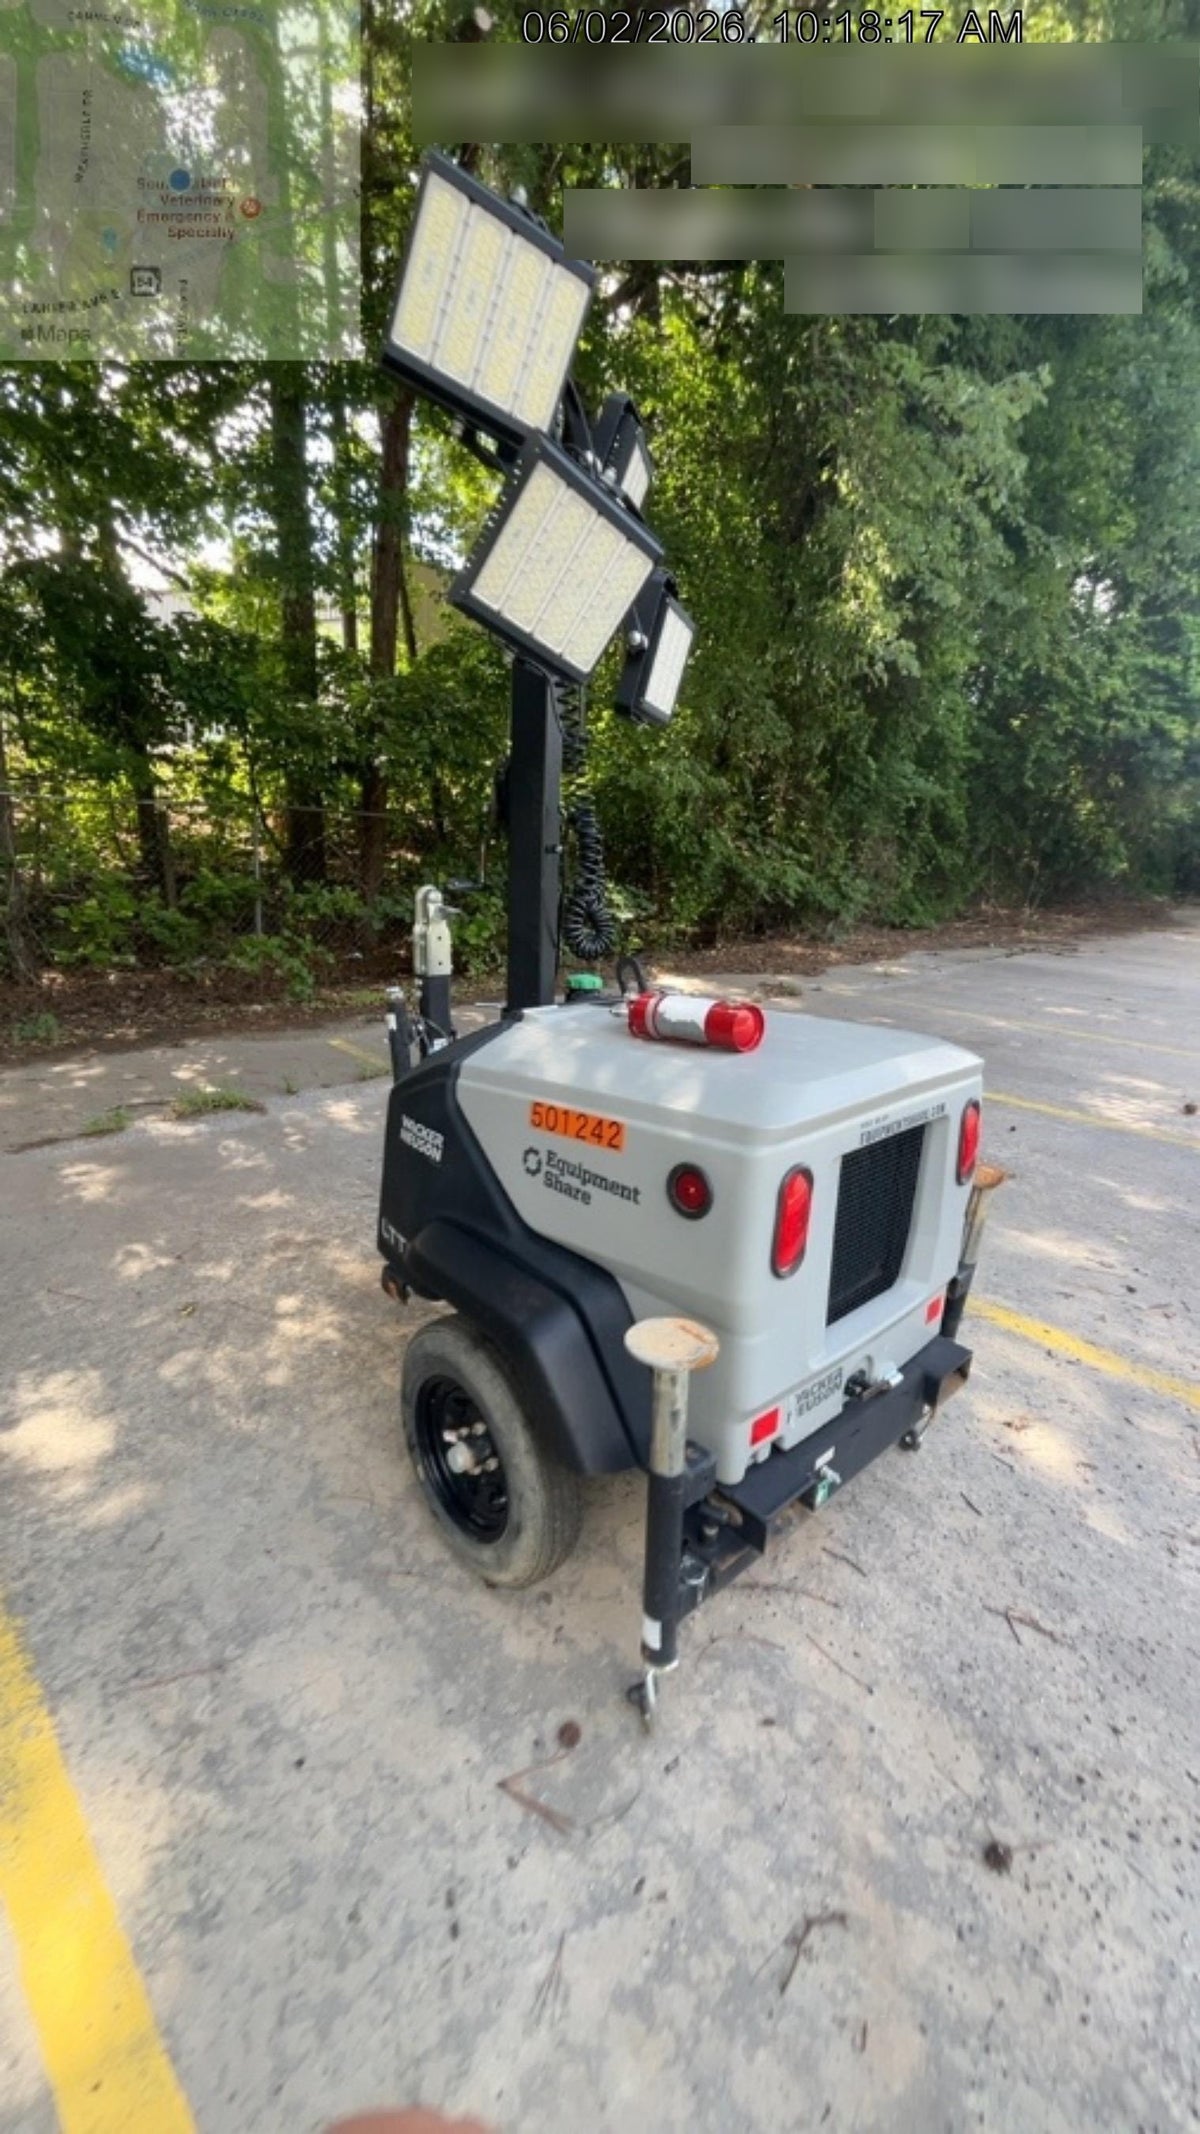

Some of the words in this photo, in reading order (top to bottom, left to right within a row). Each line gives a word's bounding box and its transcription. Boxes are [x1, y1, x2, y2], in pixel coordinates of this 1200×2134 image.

[530, 1101, 622, 1149] 501242
[543, 1171, 592, 1206] Share
[545, 1149, 641, 1205] Equipment
